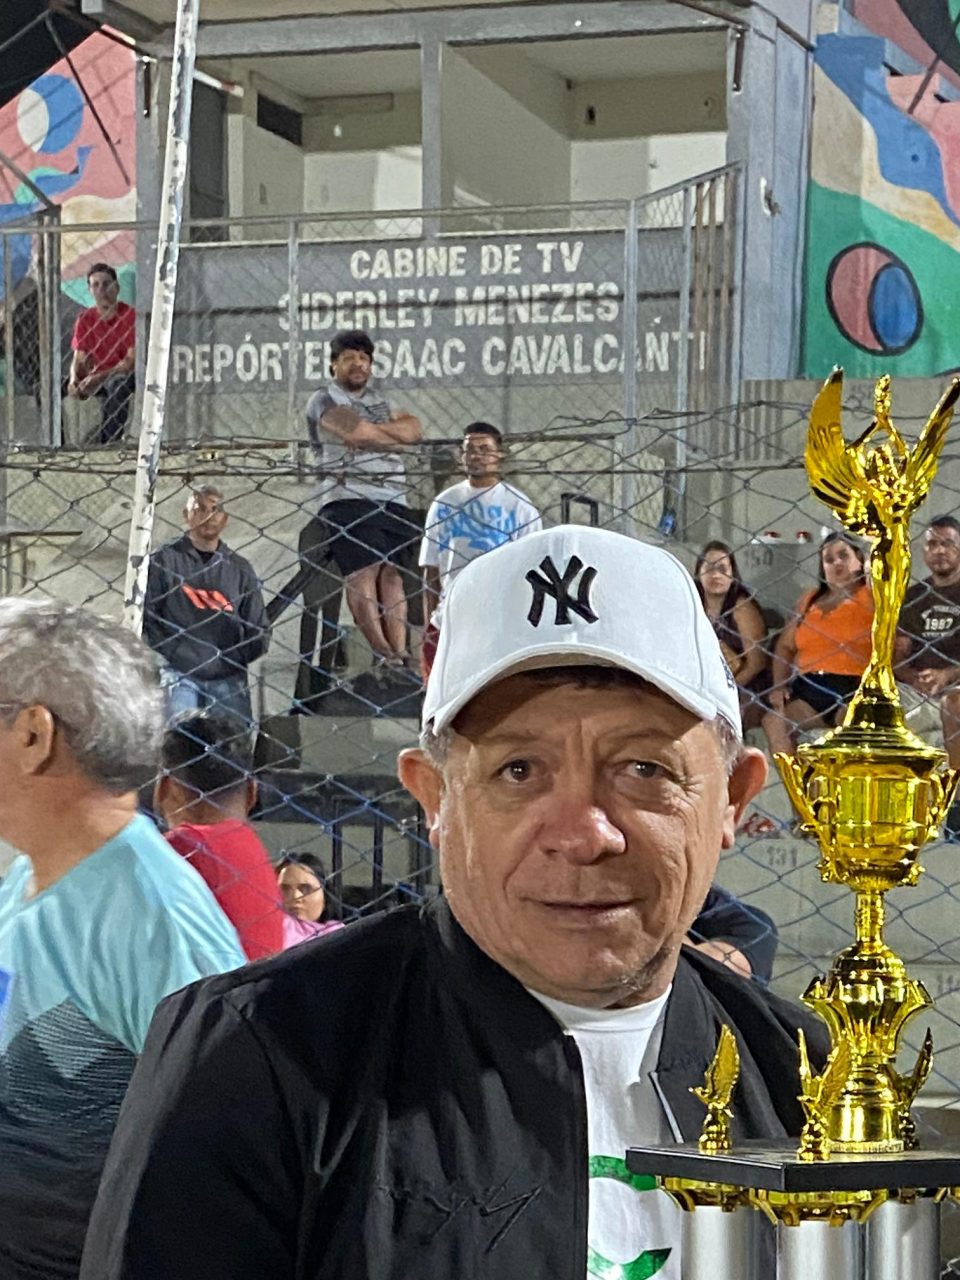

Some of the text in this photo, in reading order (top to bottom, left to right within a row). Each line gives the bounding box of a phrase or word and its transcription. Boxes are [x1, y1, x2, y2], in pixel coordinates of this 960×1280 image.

[351, 241, 584, 279] CABINE DE TV
[455, 281, 620, 326] MENEZES
[172, 332, 334, 384] REPÓRE
[371, 337, 467, 378] SAAC
[525, 555, 600, 628] NY
